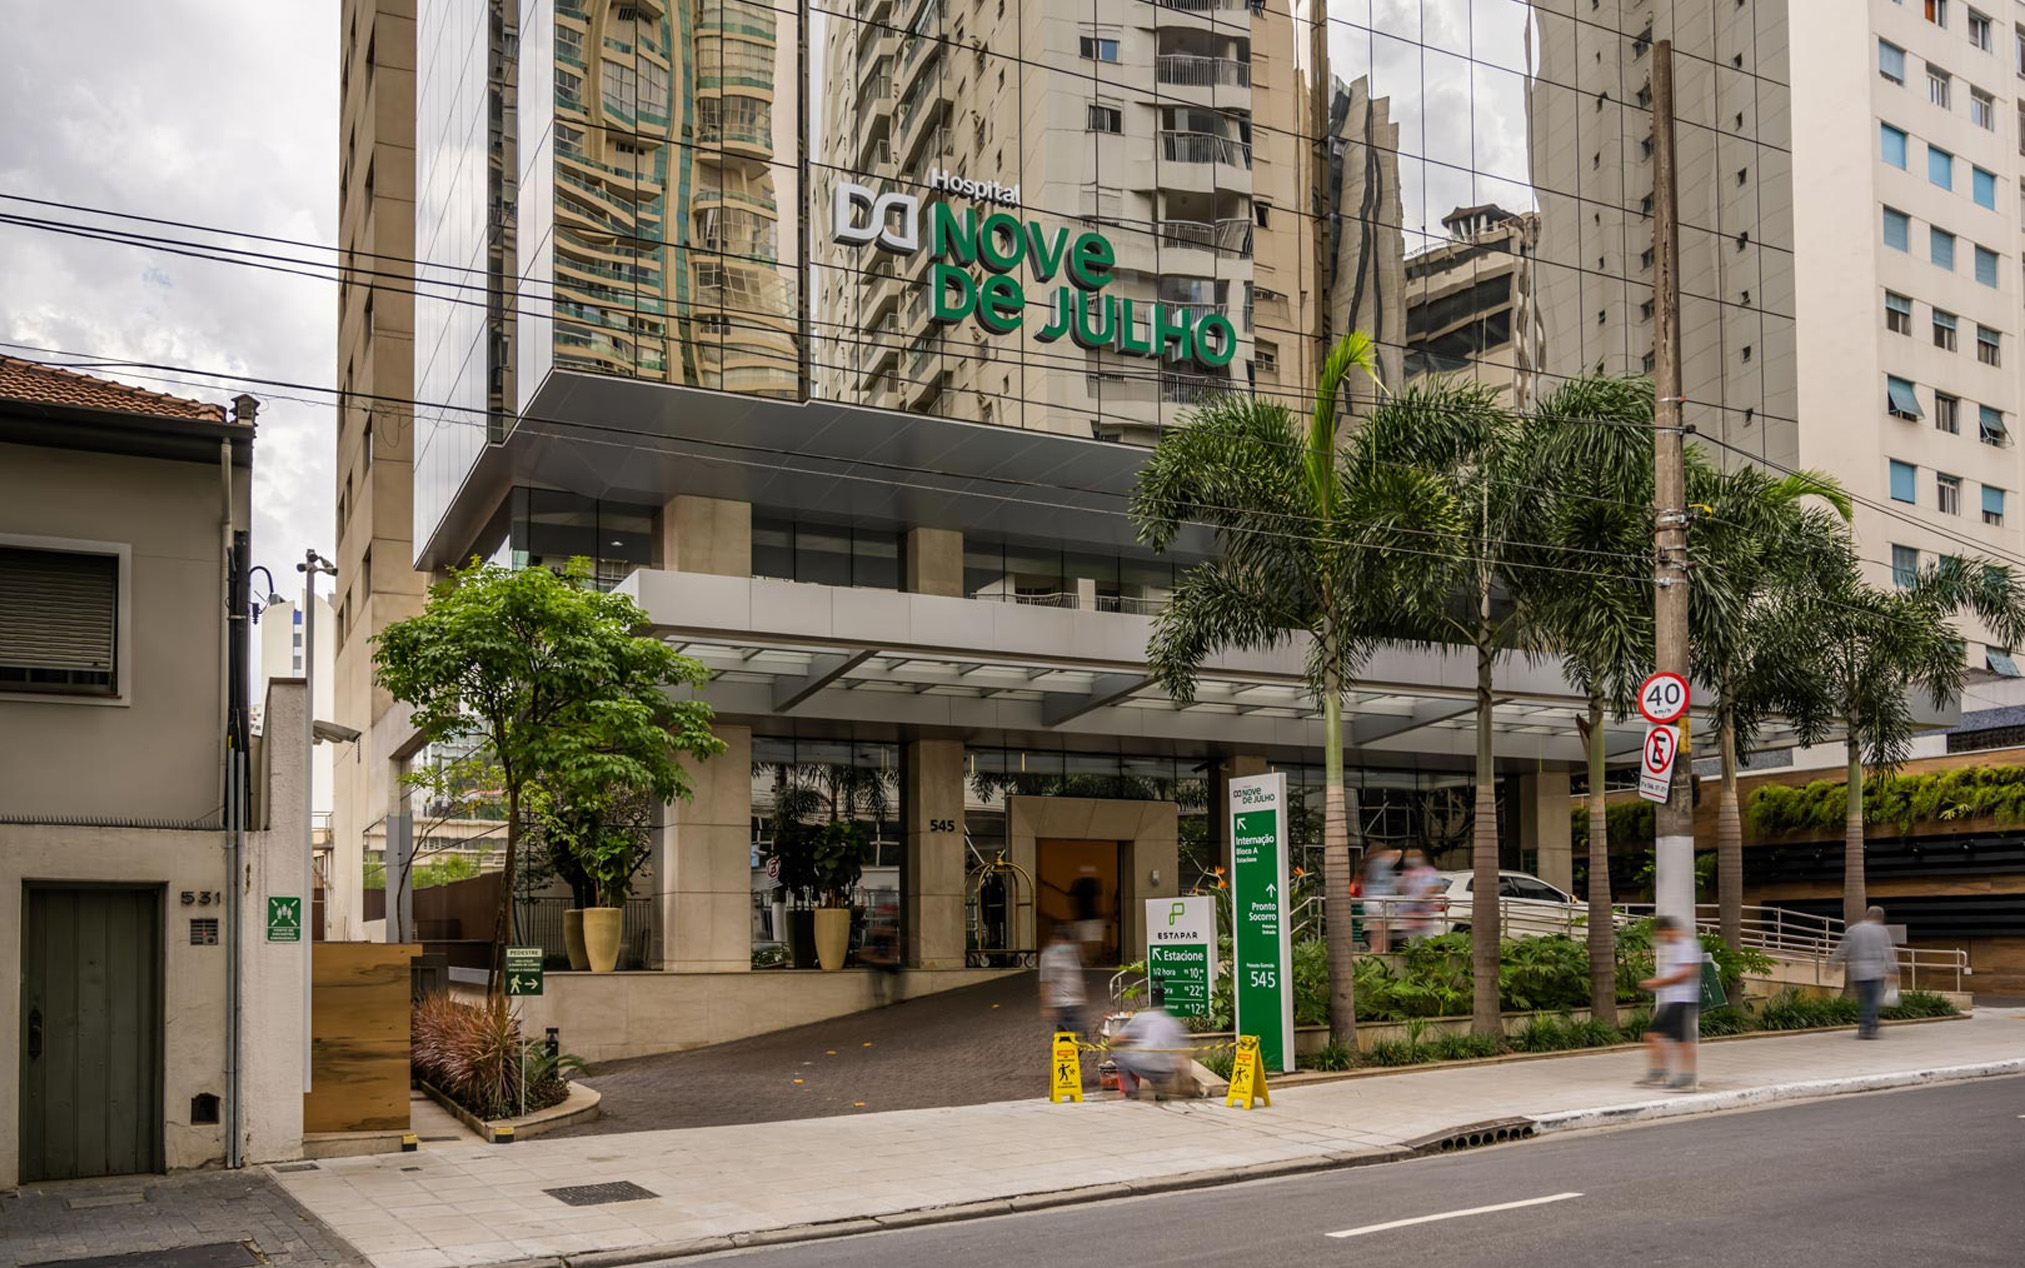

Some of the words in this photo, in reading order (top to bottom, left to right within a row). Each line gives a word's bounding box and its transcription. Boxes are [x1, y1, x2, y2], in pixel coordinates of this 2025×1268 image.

[930, 167, 1021, 205] Hospital
[1033, 285, 1238, 367] JULHO
[1646, 683, 1680, 706] 40
[1253, 794, 1275, 803] JULHO
[930, 819, 955, 832] 545
[1236, 834, 1275, 846] Internação
[181, 891, 221, 905] 531
[1252, 902, 1277, 911] Pronto
[1249, 912, 1277, 921] Socorro
[1157, 931, 1198, 940] ESTAPAR
[1163, 950, 1204, 961] Estacione
[1162, 967, 1176, 976] hora
[1250, 971, 1276, 988] 545
